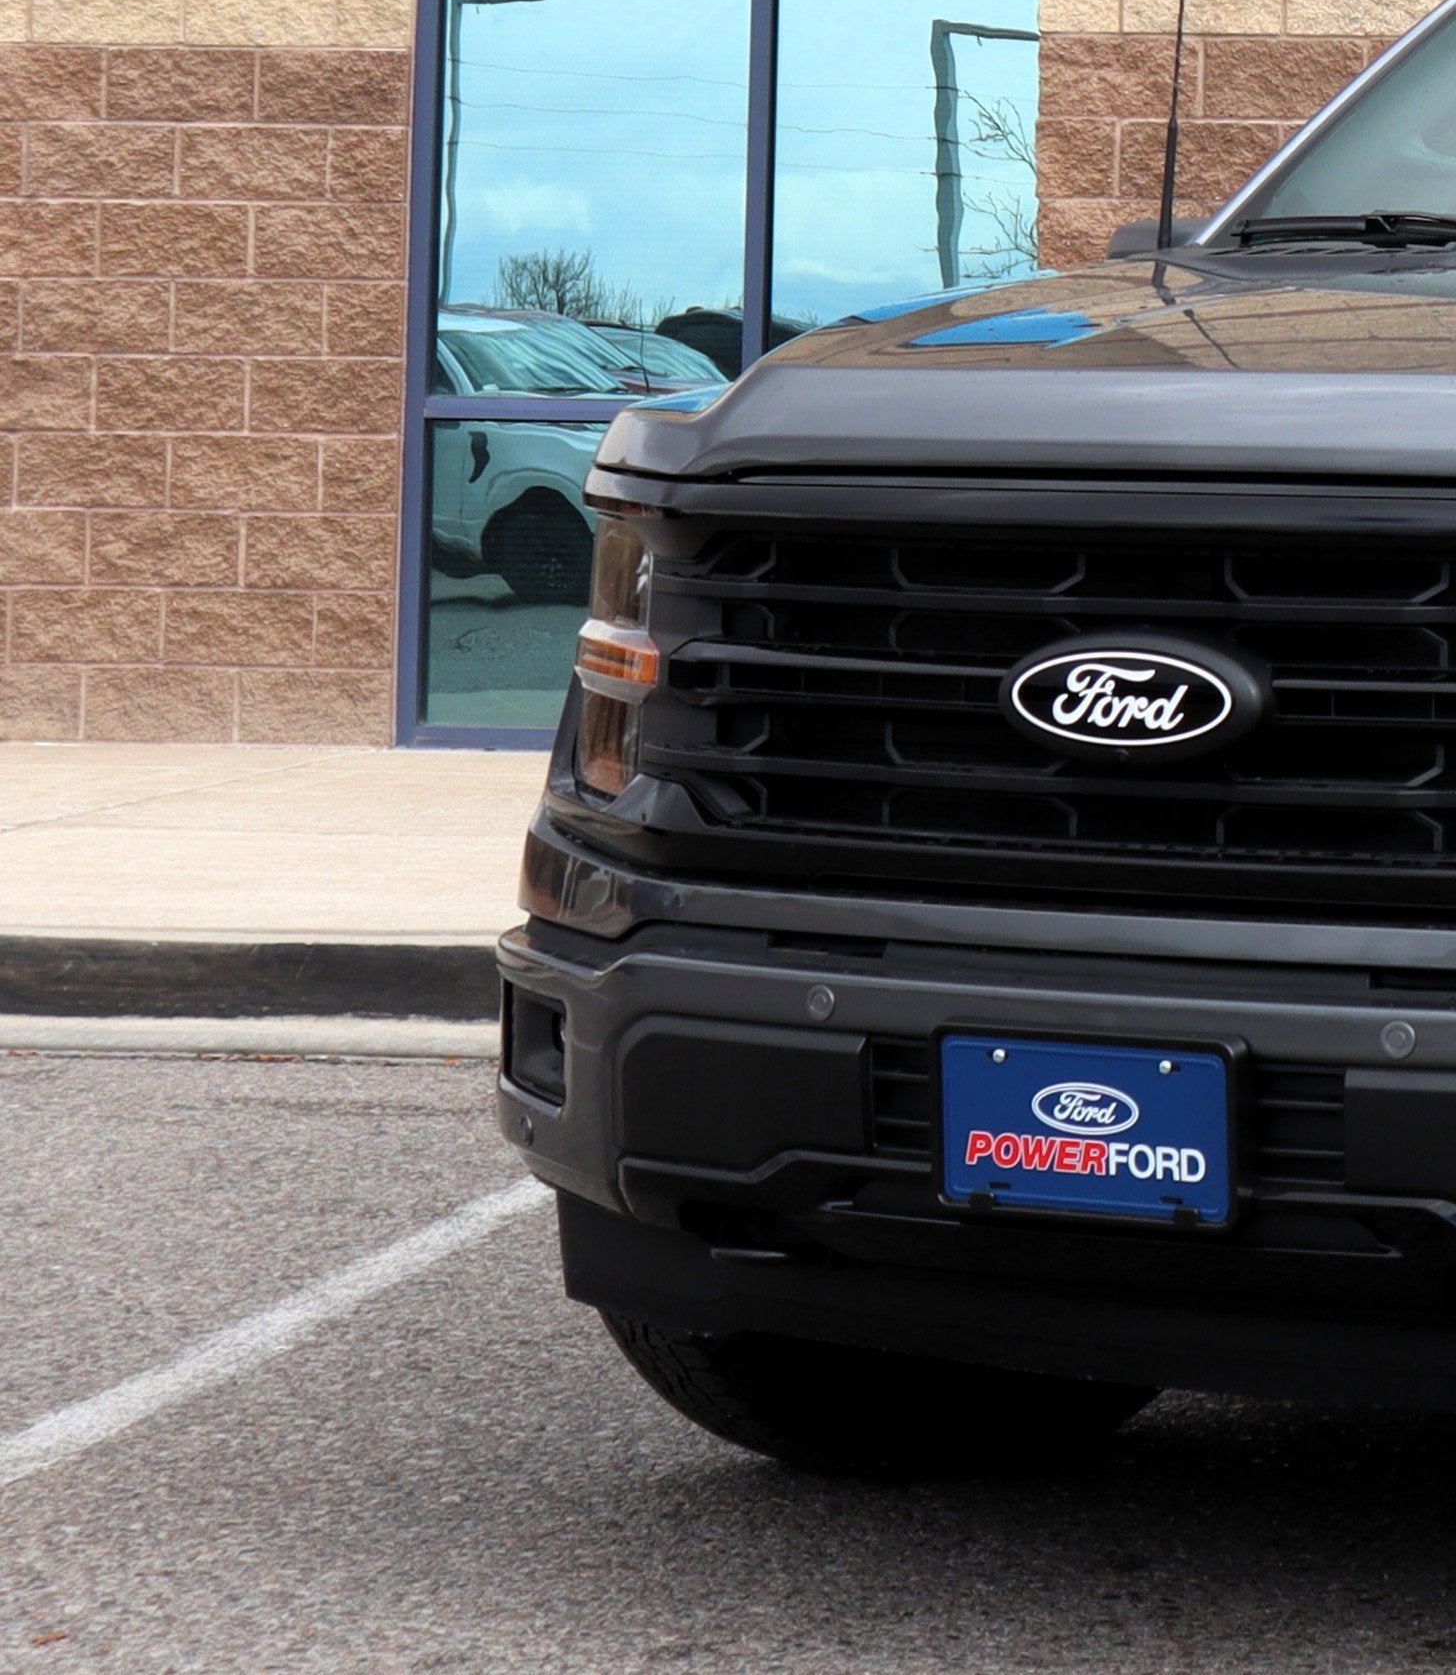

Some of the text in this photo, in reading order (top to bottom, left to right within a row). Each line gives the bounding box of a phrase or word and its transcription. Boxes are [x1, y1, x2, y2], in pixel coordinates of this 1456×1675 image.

[1052, 663, 1188, 731] Ford
[1053, 1090, 1117, 1125] Ford
[965, 1130, 1206, 1183] POWERFORD
